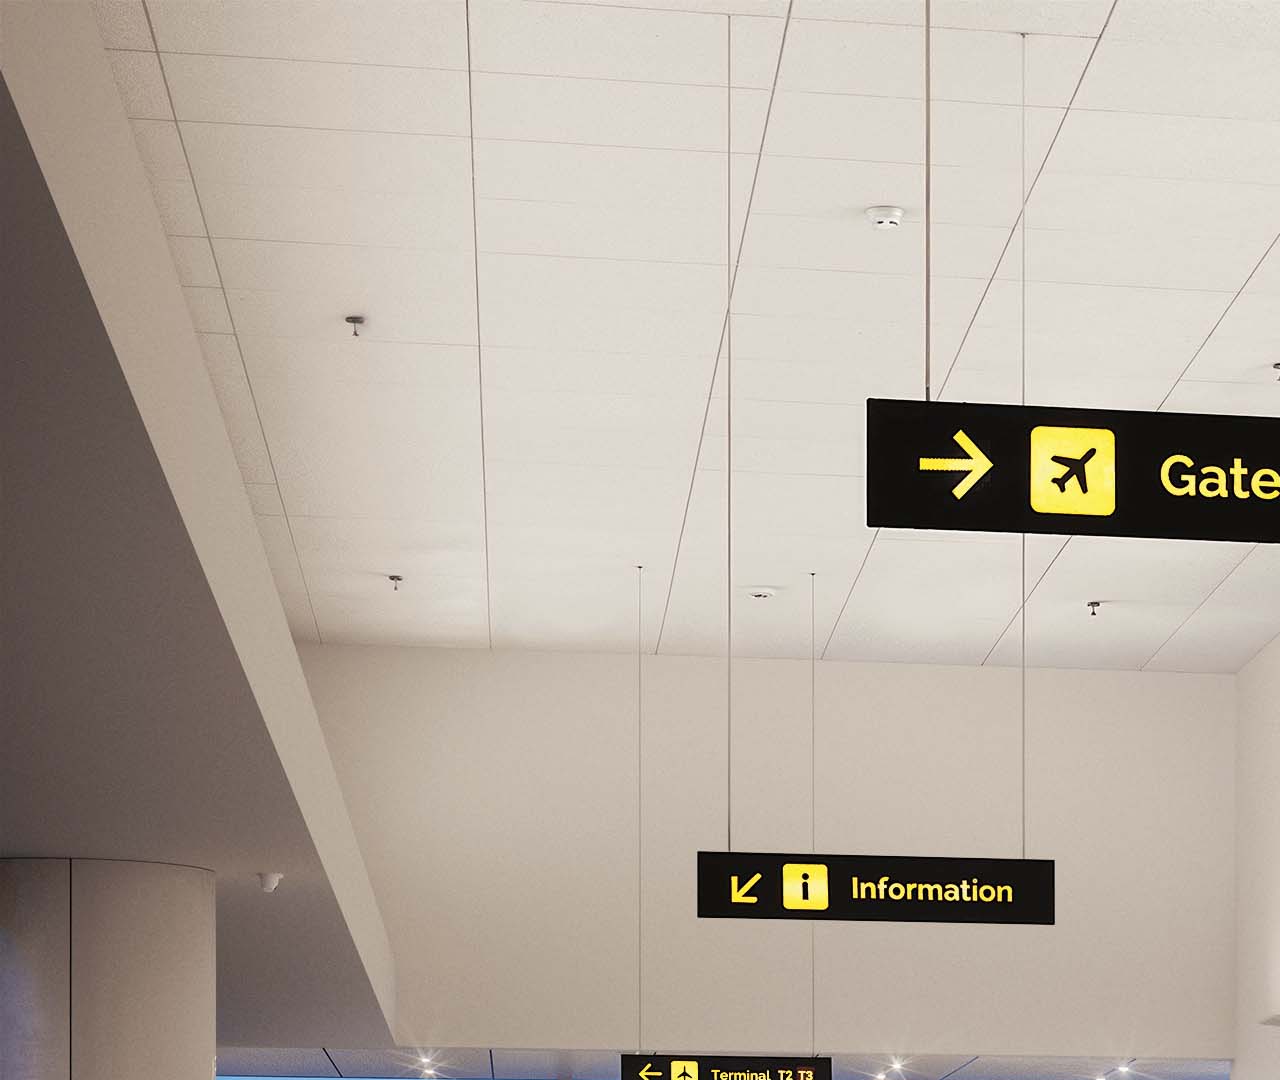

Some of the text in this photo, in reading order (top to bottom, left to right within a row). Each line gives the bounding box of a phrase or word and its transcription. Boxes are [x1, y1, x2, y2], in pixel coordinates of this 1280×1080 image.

[851, 876, 1014, 903] Information
[710, 1070, 813, 1080] Terminal T2 T3
